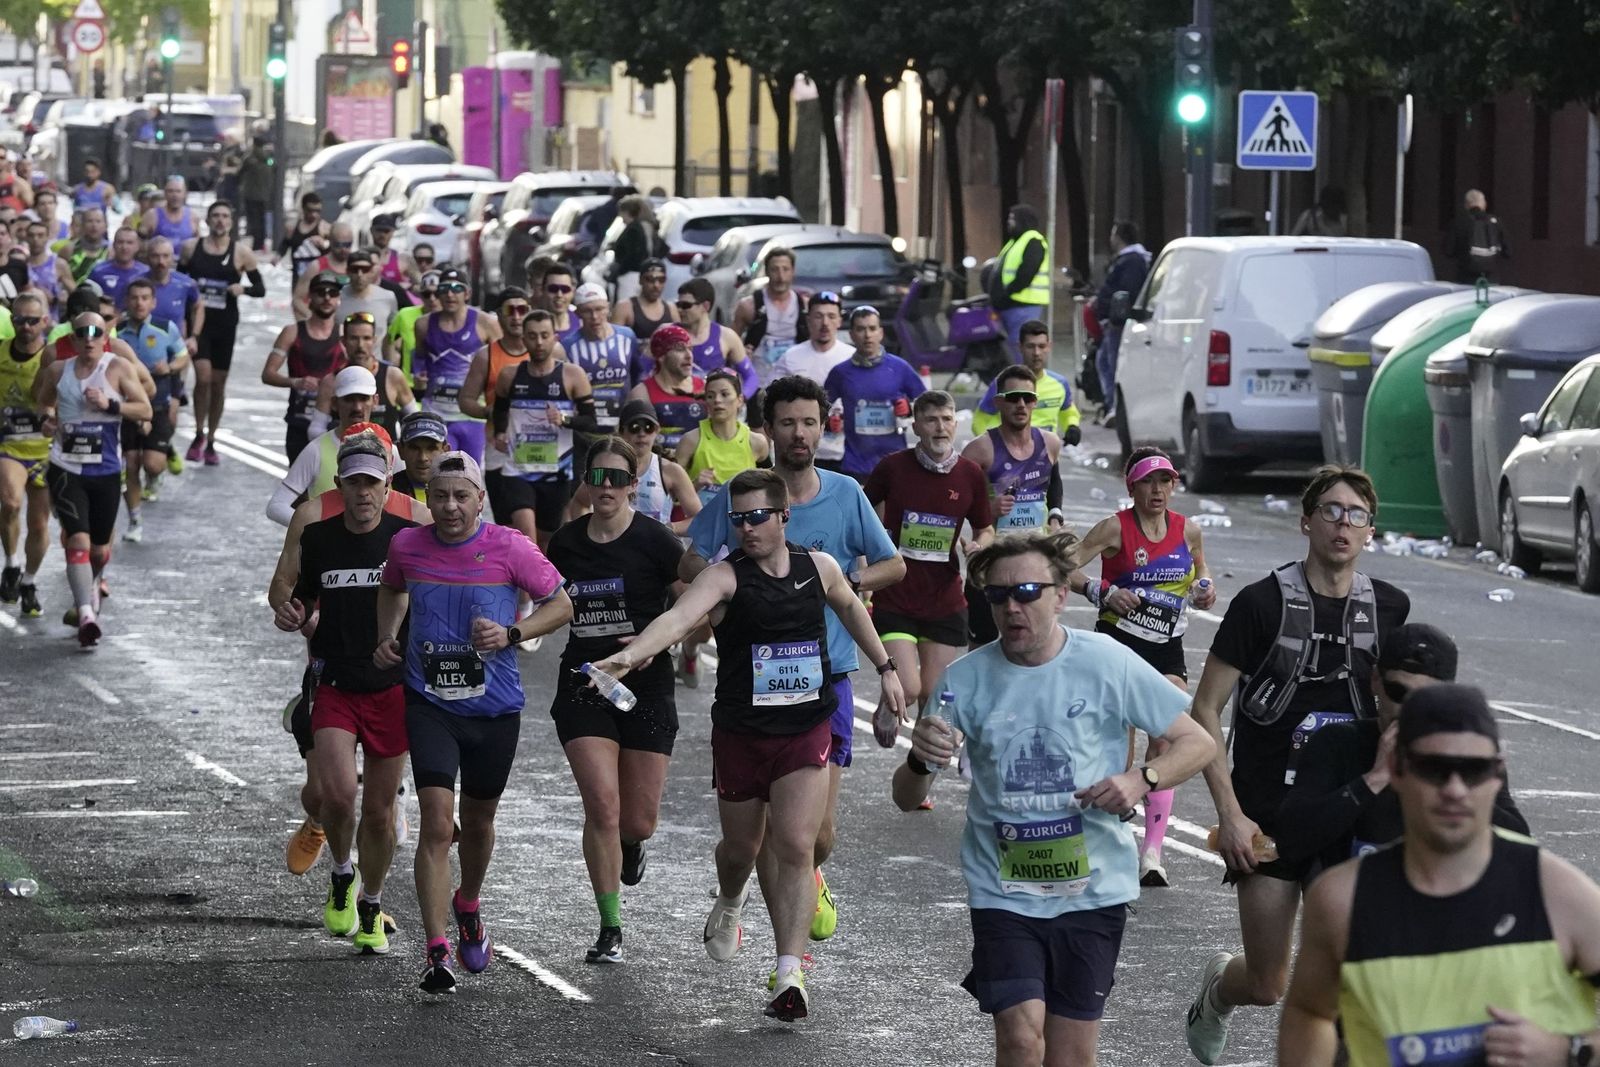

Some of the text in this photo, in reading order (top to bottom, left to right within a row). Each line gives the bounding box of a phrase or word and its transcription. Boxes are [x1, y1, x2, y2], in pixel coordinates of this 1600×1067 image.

[596, 367, 627, 379] GÖTA
[1255, 379, 1286, 392] 9177
[1025, 470, 1041, 481] AGEN
[1016, 493, 1041, 501] ZURICH
[921, 515, 951, 526] ZURICH
[1010, 516, 1036, 527] KEVIN
[907, 537, 943, 551] SERGIO
[1132, 571, 1186, 582] PALACIEGO
[582, 582, 617, 593] ZURICH
[1149, 591, 1178, 605] ZURICH
[1145, 605, 1163, 617] 4434
[572, 609, 628, 626] LAMPRINI
[1126, 608, 1171, 635] CANSINA
[437, 643, 474, 653] ZURICH
[777, 645, 813, 656] ZURICH
[440, 661, 460, 671] 5200
[778, 665, 799, 675] 6114
[436, 673, 468, 686] ALEX
[768, 676, 810, 691] SALAS
[1022, 822, 1073, 838] ZURICH
[1027, 848, 1054, 860] 2407
[1010, 859, 1080, 880] ANDREW
